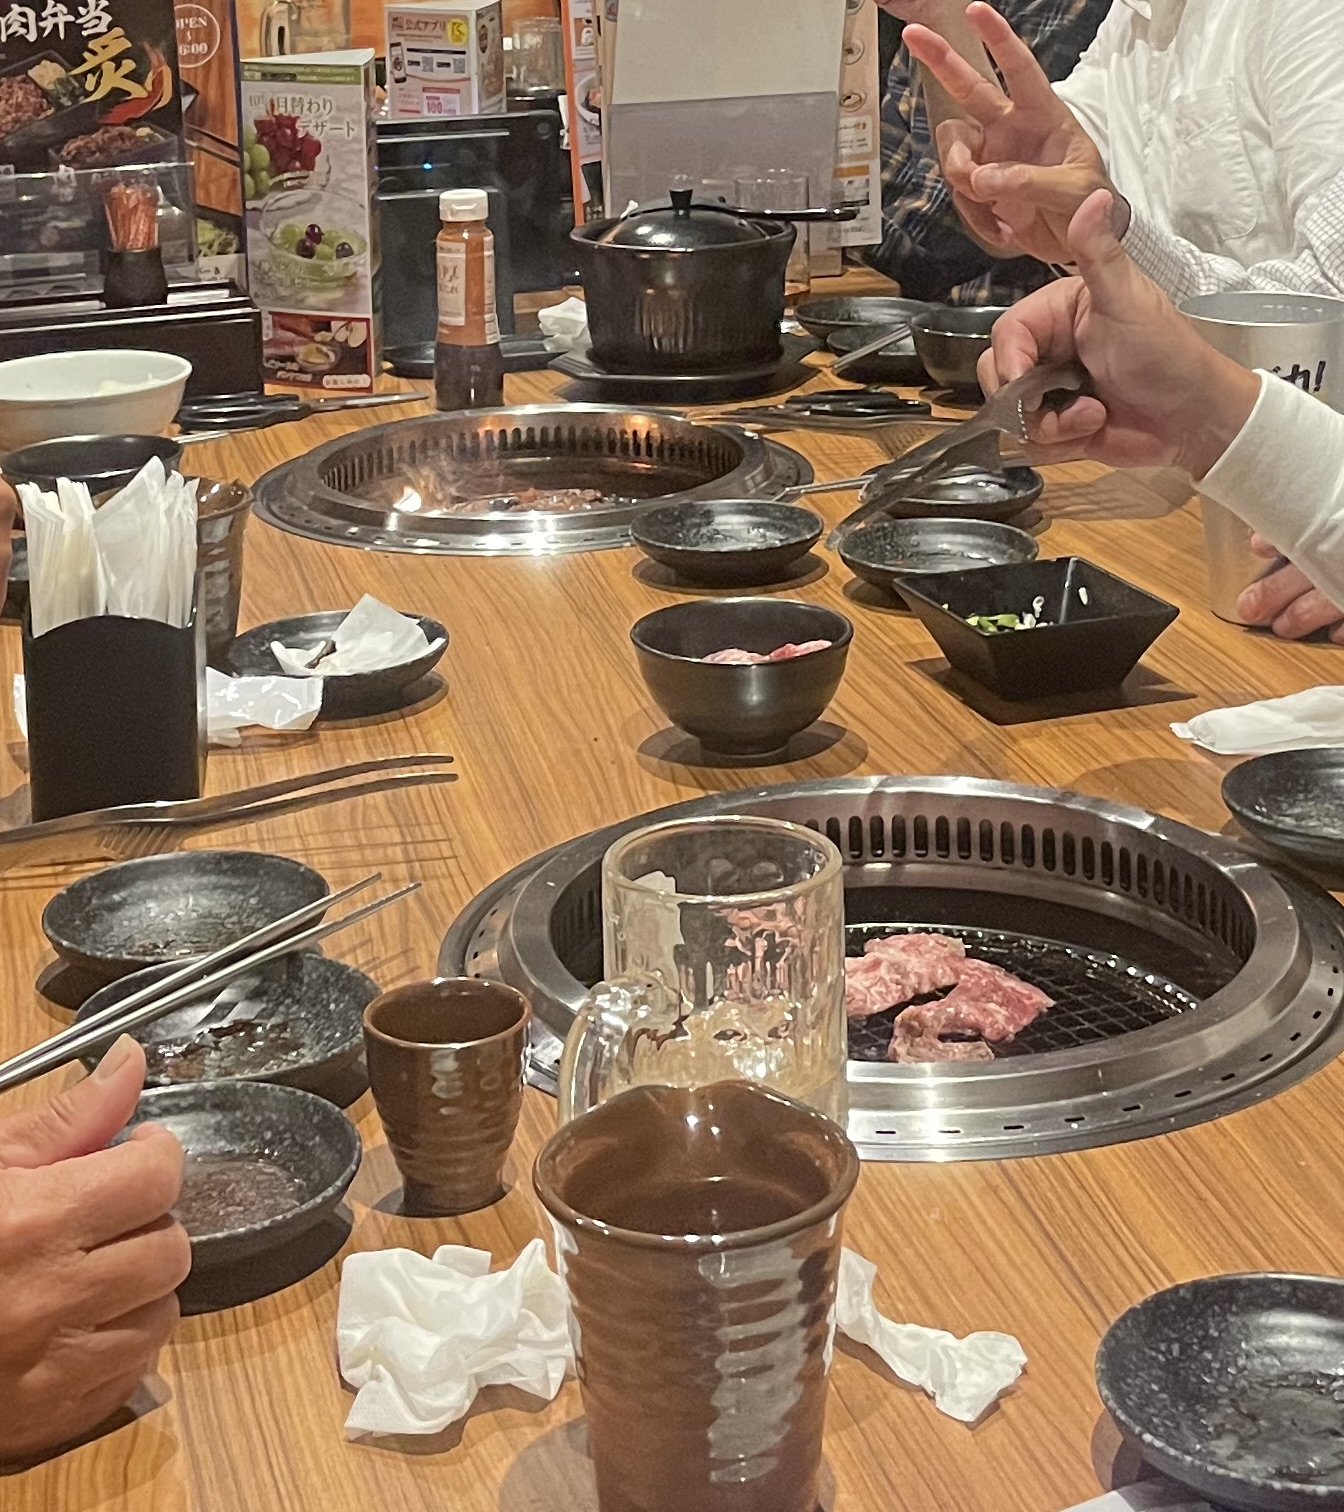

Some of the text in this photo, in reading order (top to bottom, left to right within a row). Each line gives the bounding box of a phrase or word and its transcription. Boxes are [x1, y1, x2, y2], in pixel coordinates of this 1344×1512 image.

[67, 26, 150, 104] 炙
[298, 120, 356, 138] デザート
